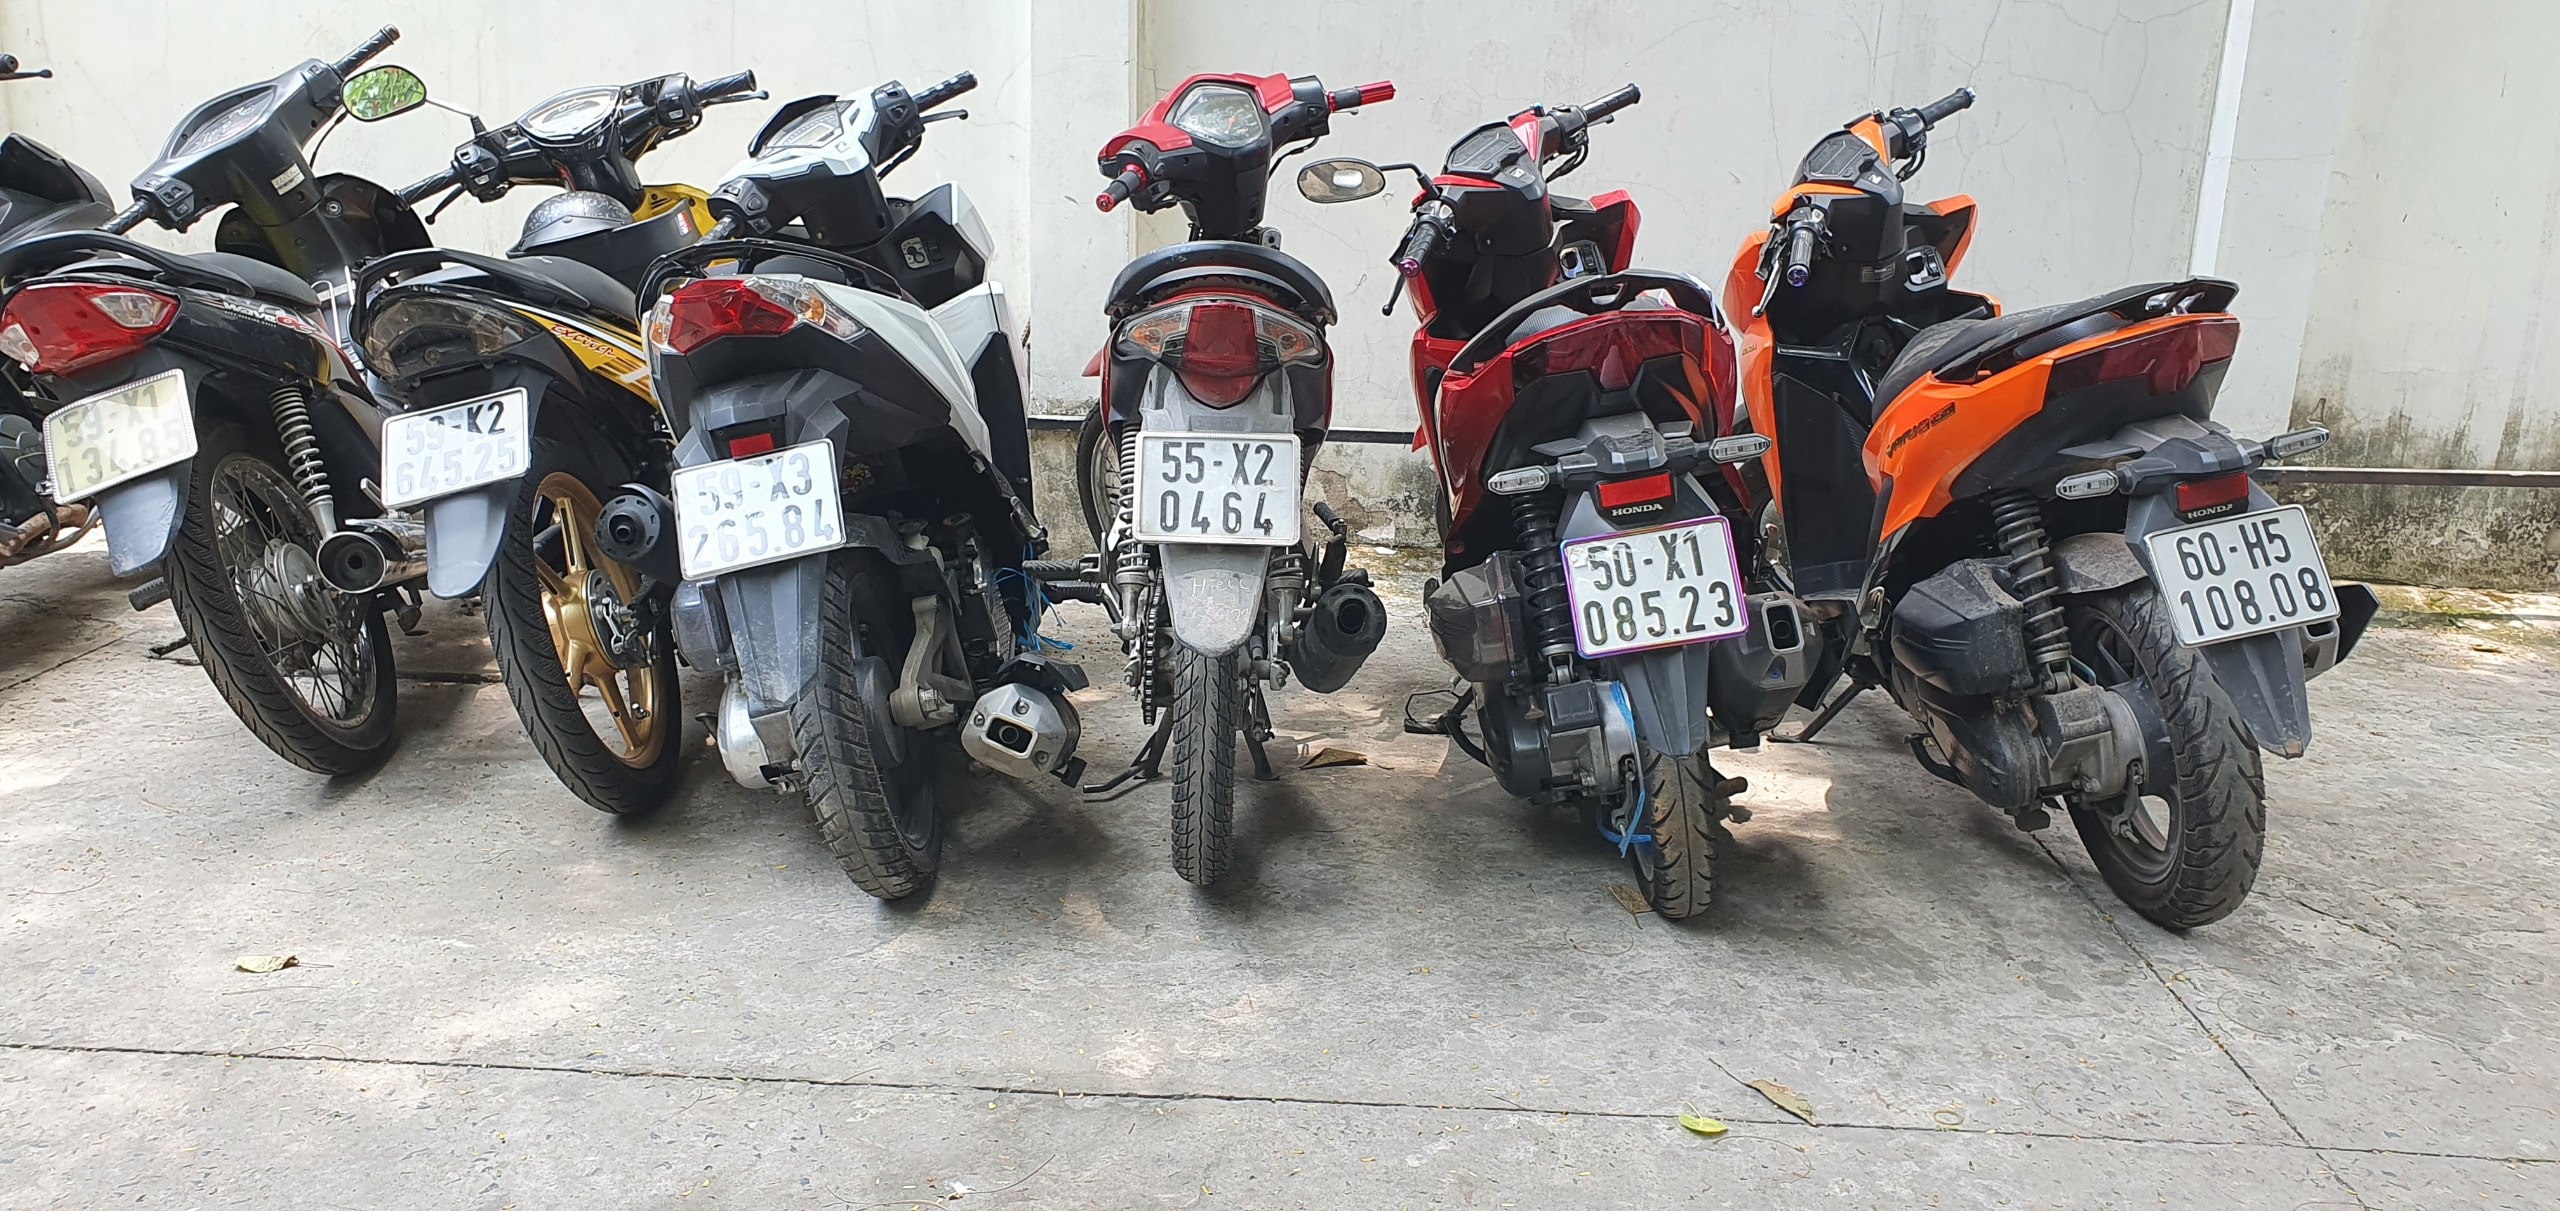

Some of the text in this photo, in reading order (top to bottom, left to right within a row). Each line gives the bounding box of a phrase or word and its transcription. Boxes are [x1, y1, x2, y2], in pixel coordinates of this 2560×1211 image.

[60, 384, 160, 448] 59-X1
[406, 400, 506, 457] 59-K2
[396, 435, 518, 497] 645.25
[696, 452, 813, 516] 59-X3
[1162, 441, 1274, 487] 55-X2
[687, 498, 835, 571] 265.84
[1159, 489, 1274, 536] 0464
[1611, 503, 1664, 517] HONDA
[1586, 529, 1705, 591] 50-X1
[2175, 517, 2292, 581] 60-H5
[1582, 580, 1736, 647] 085.23
[2179, 566, 2327, 637] 108.08
